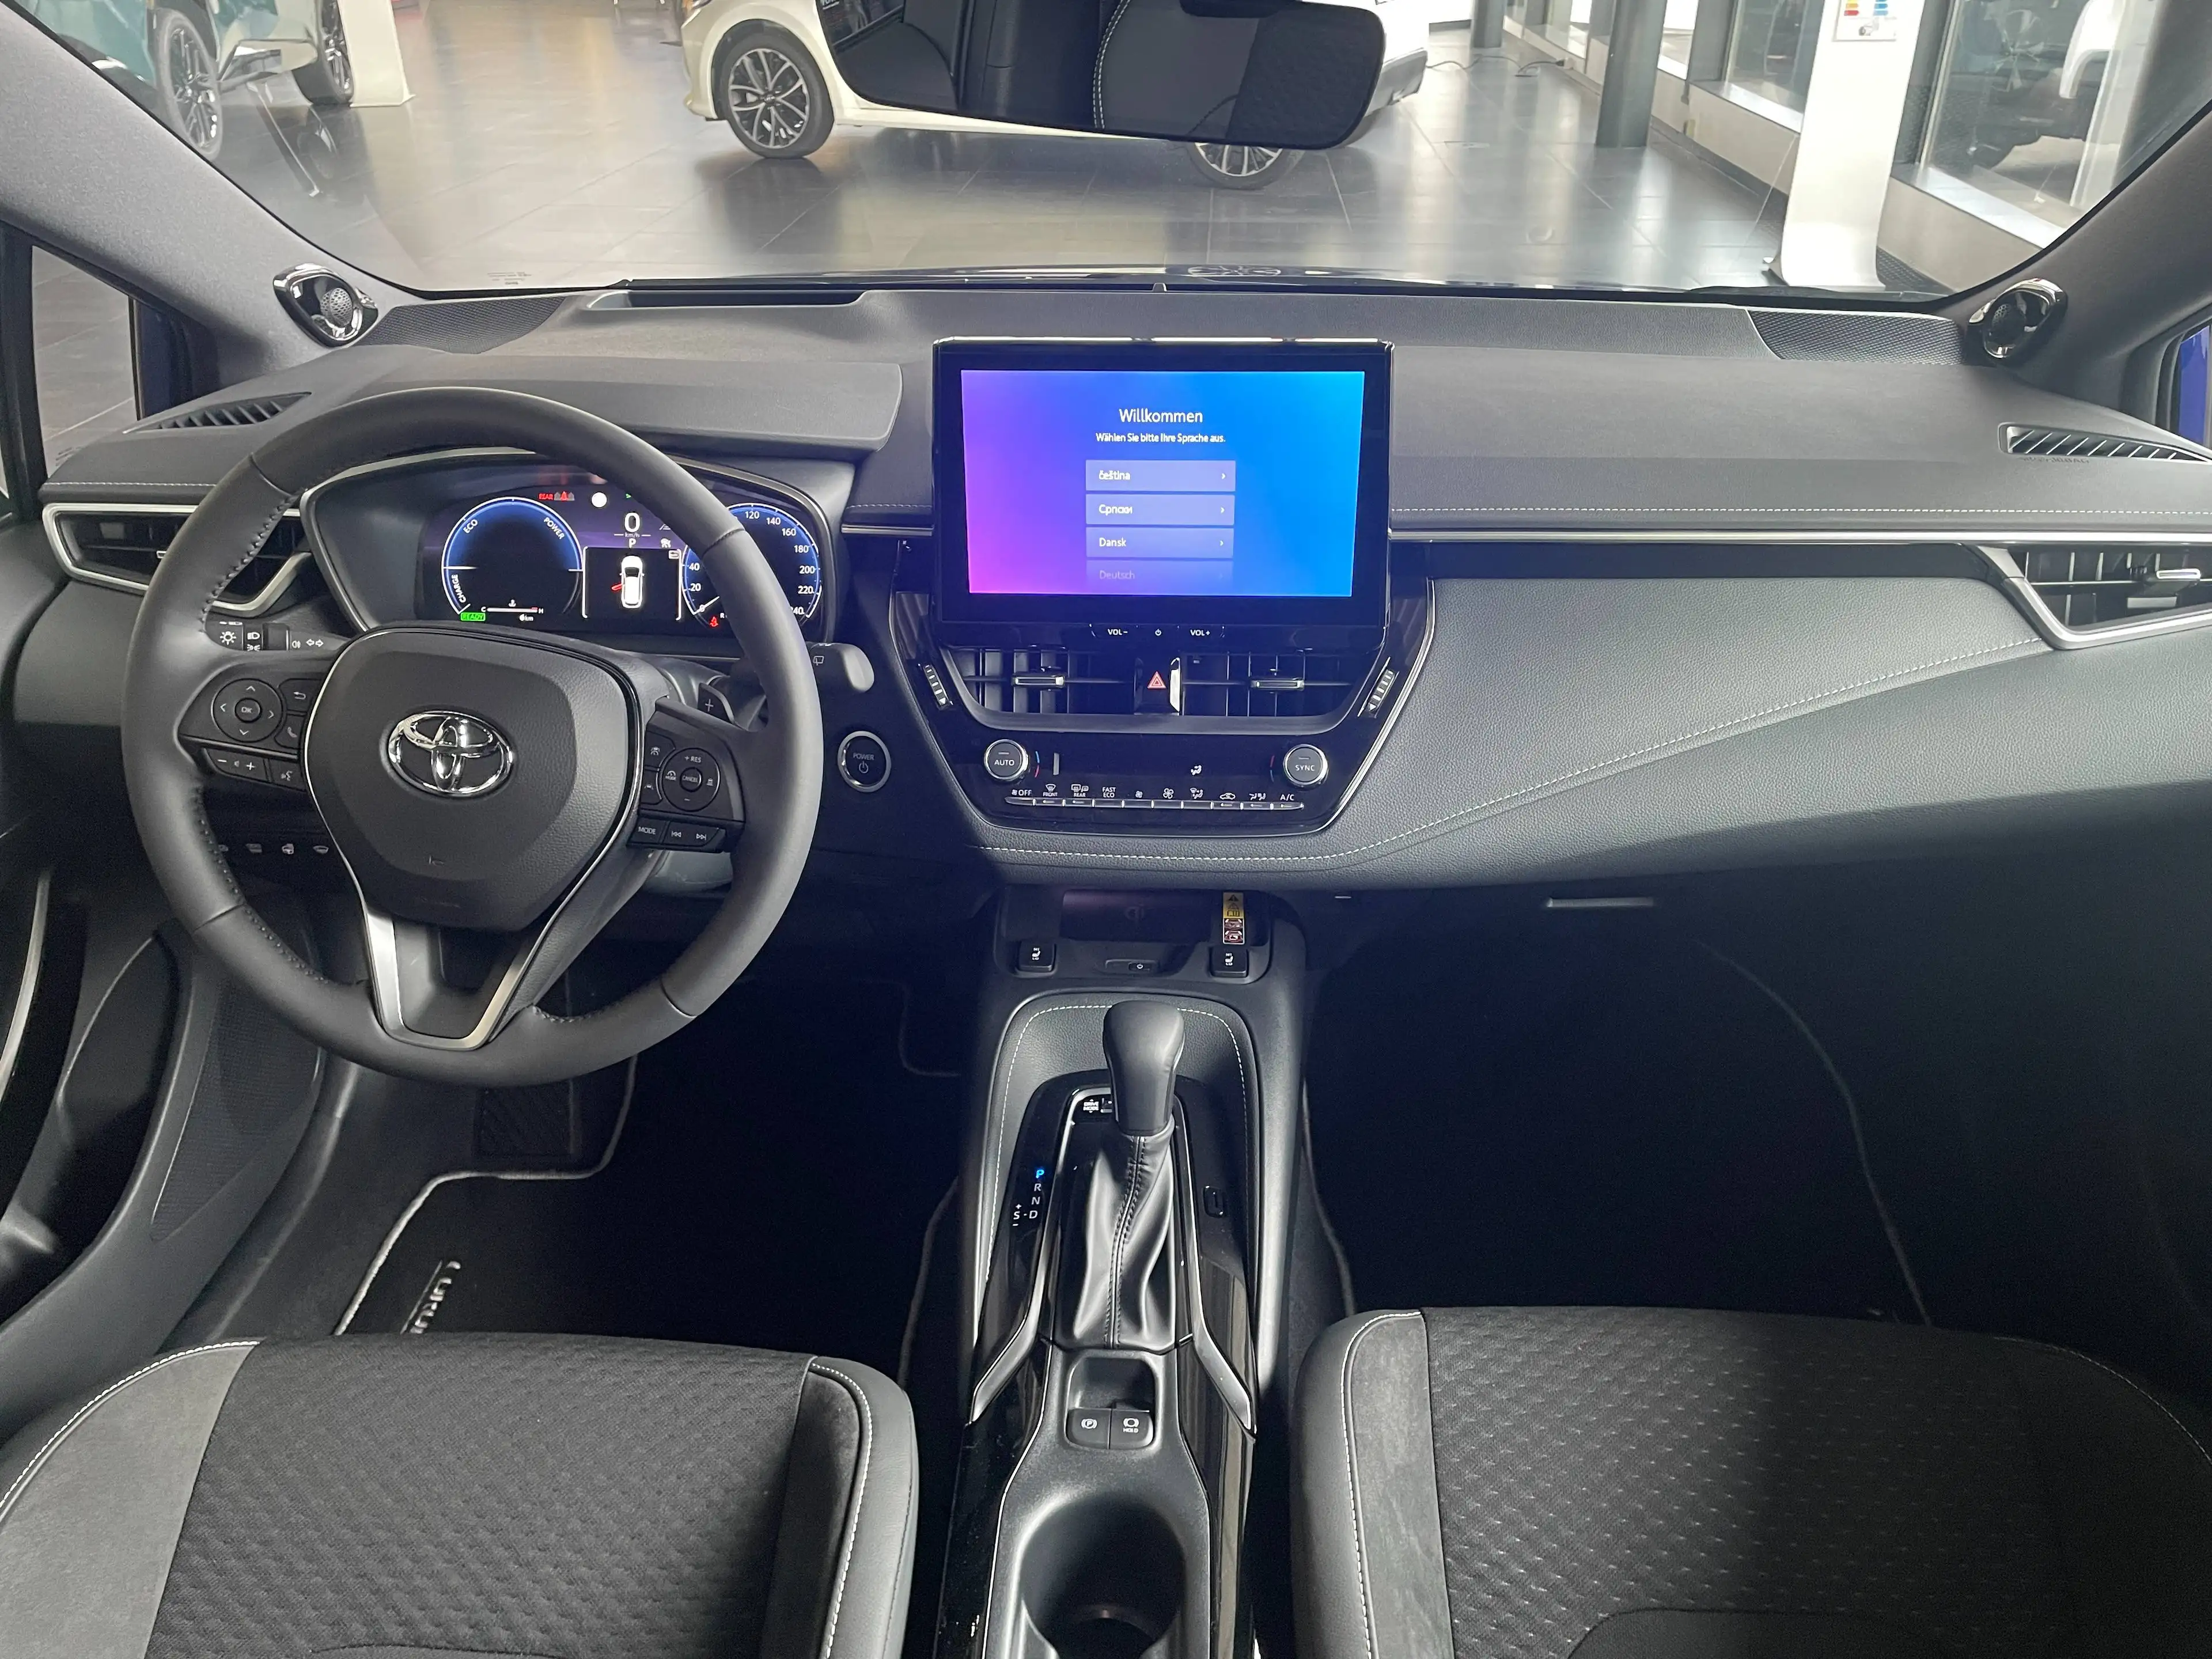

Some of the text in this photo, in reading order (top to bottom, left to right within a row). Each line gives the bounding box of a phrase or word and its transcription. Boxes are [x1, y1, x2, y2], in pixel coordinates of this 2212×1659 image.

[1119, 408, 1203, 423] Willkommen
[1096, 433, 1226, 445] Wählen Sie bitte Ihre Sprache aus.
[745, 510, 760, 520] 120
[624, 512, 641, 533] 0
[767, 517, 781, 525] 140
[463, 518, 479, 534] ECO
[543, 516, 565, 540] POWER
[782, 528, 797, 536] 160
[628, 538, 637, 548] P
[1099, 537, 1127, 547] Dansk
[794, 545, 809, 553] 180
[689, 562, 700, 571] 40
[799, 566, 815, 574] 200
[1099, 570, 1135, 580] Deutsch
[451, 574, 467, 604] CHARGE
[690, 583, 702, 592] 20
[798, 586, 813, 594] 220
[790, 607, 805, 615] 40
[853, 752, 874, 760] POWER
[994, 759, 1015, 767] AUTO
[682, 775, 698, 783] CANCEL
[638, 826, 656, 835] MODE
[1036, 1168, 1045, 1179] P
[1033, 1183, 1042, 1192] R
[1031, 1196, 1041, 1205] N
[1013, 1210, 1039, 1220] S D
